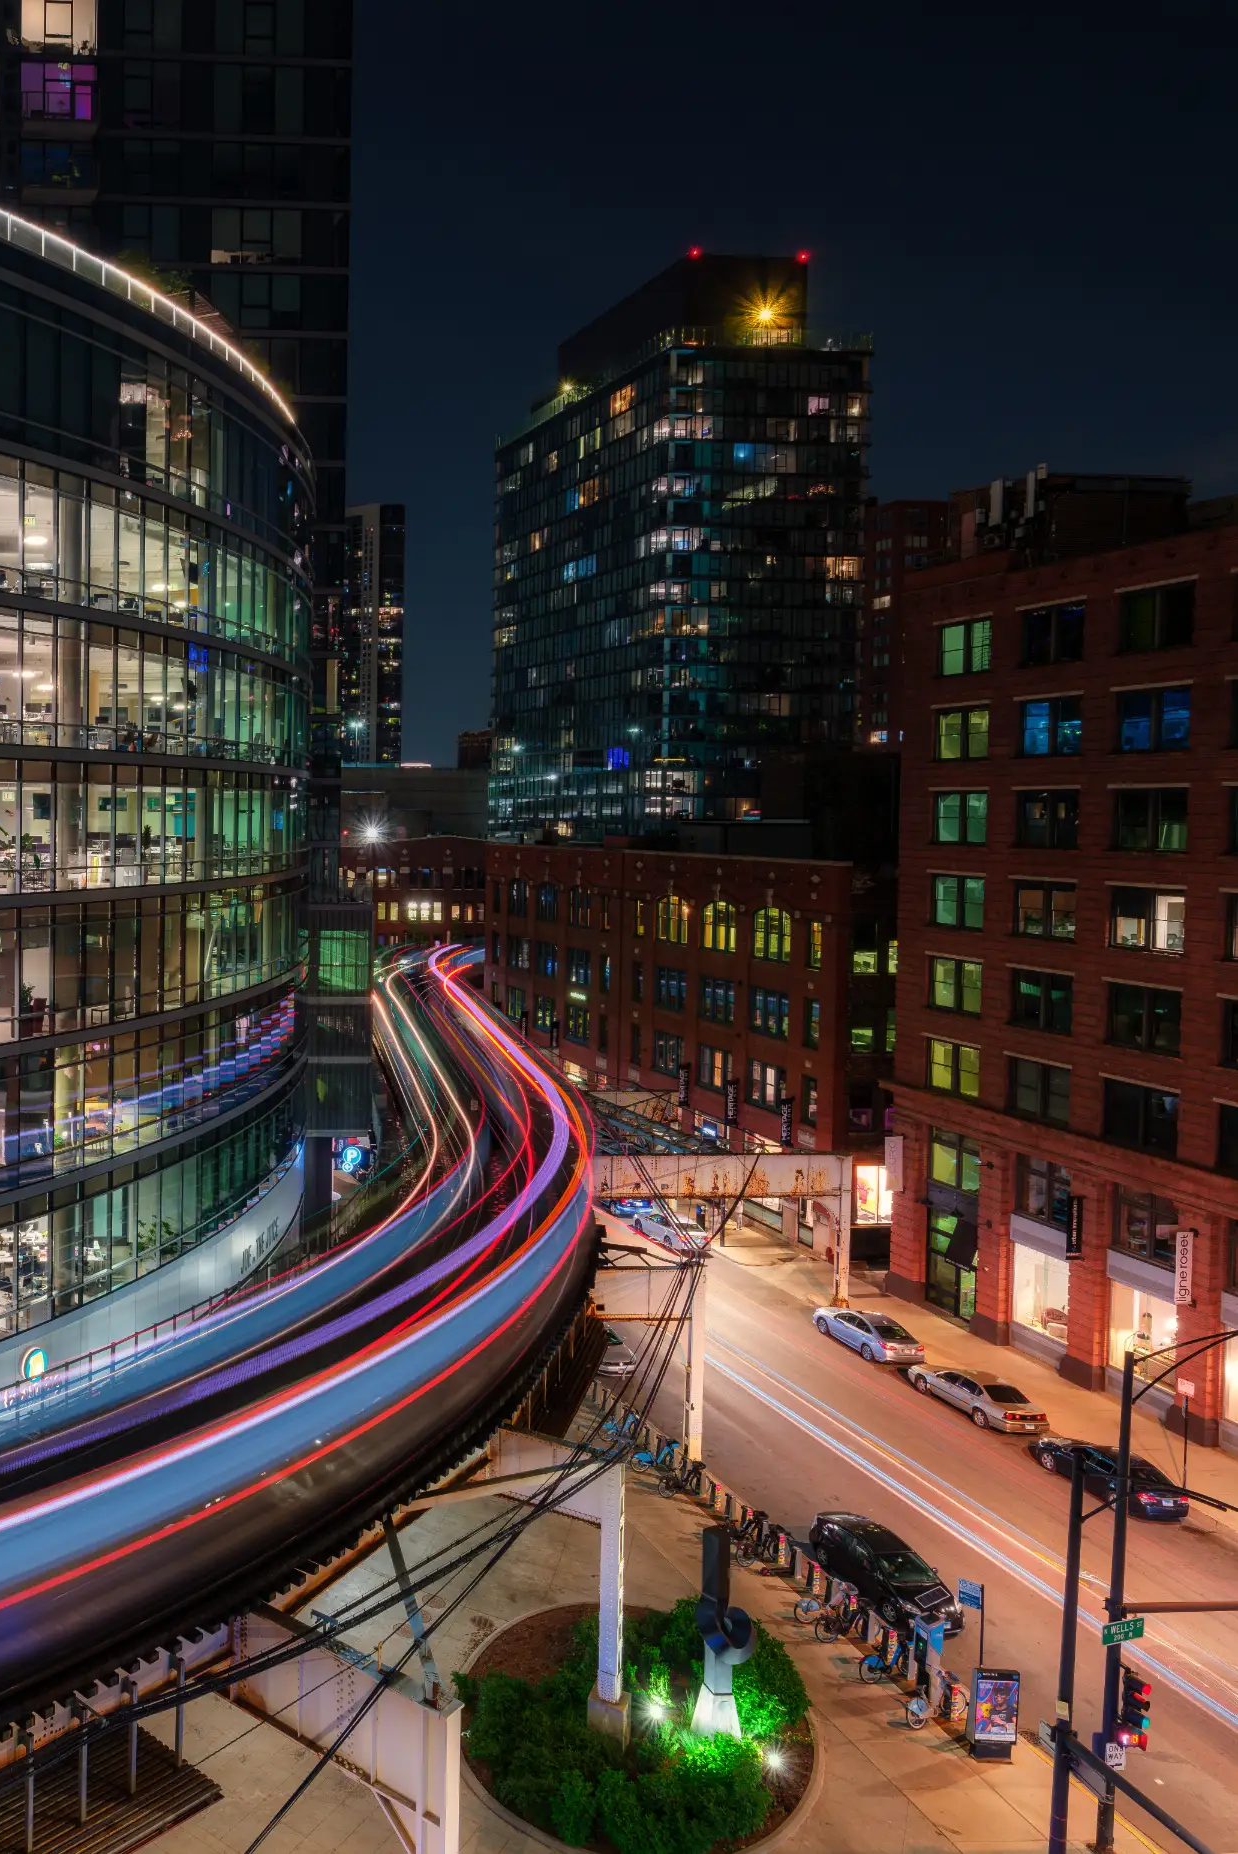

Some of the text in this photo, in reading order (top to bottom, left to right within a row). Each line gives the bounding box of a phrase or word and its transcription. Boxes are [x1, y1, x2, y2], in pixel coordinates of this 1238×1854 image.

[346, 1149, 358, 1162] P
[1176, 1234, 1190, 1302] ligne roset
[1110, 1621, 1135, 1635] WELLS
[1113, 1633, 1125, 1641] 200
[1107, 1752, 1124, 1760] WAY
